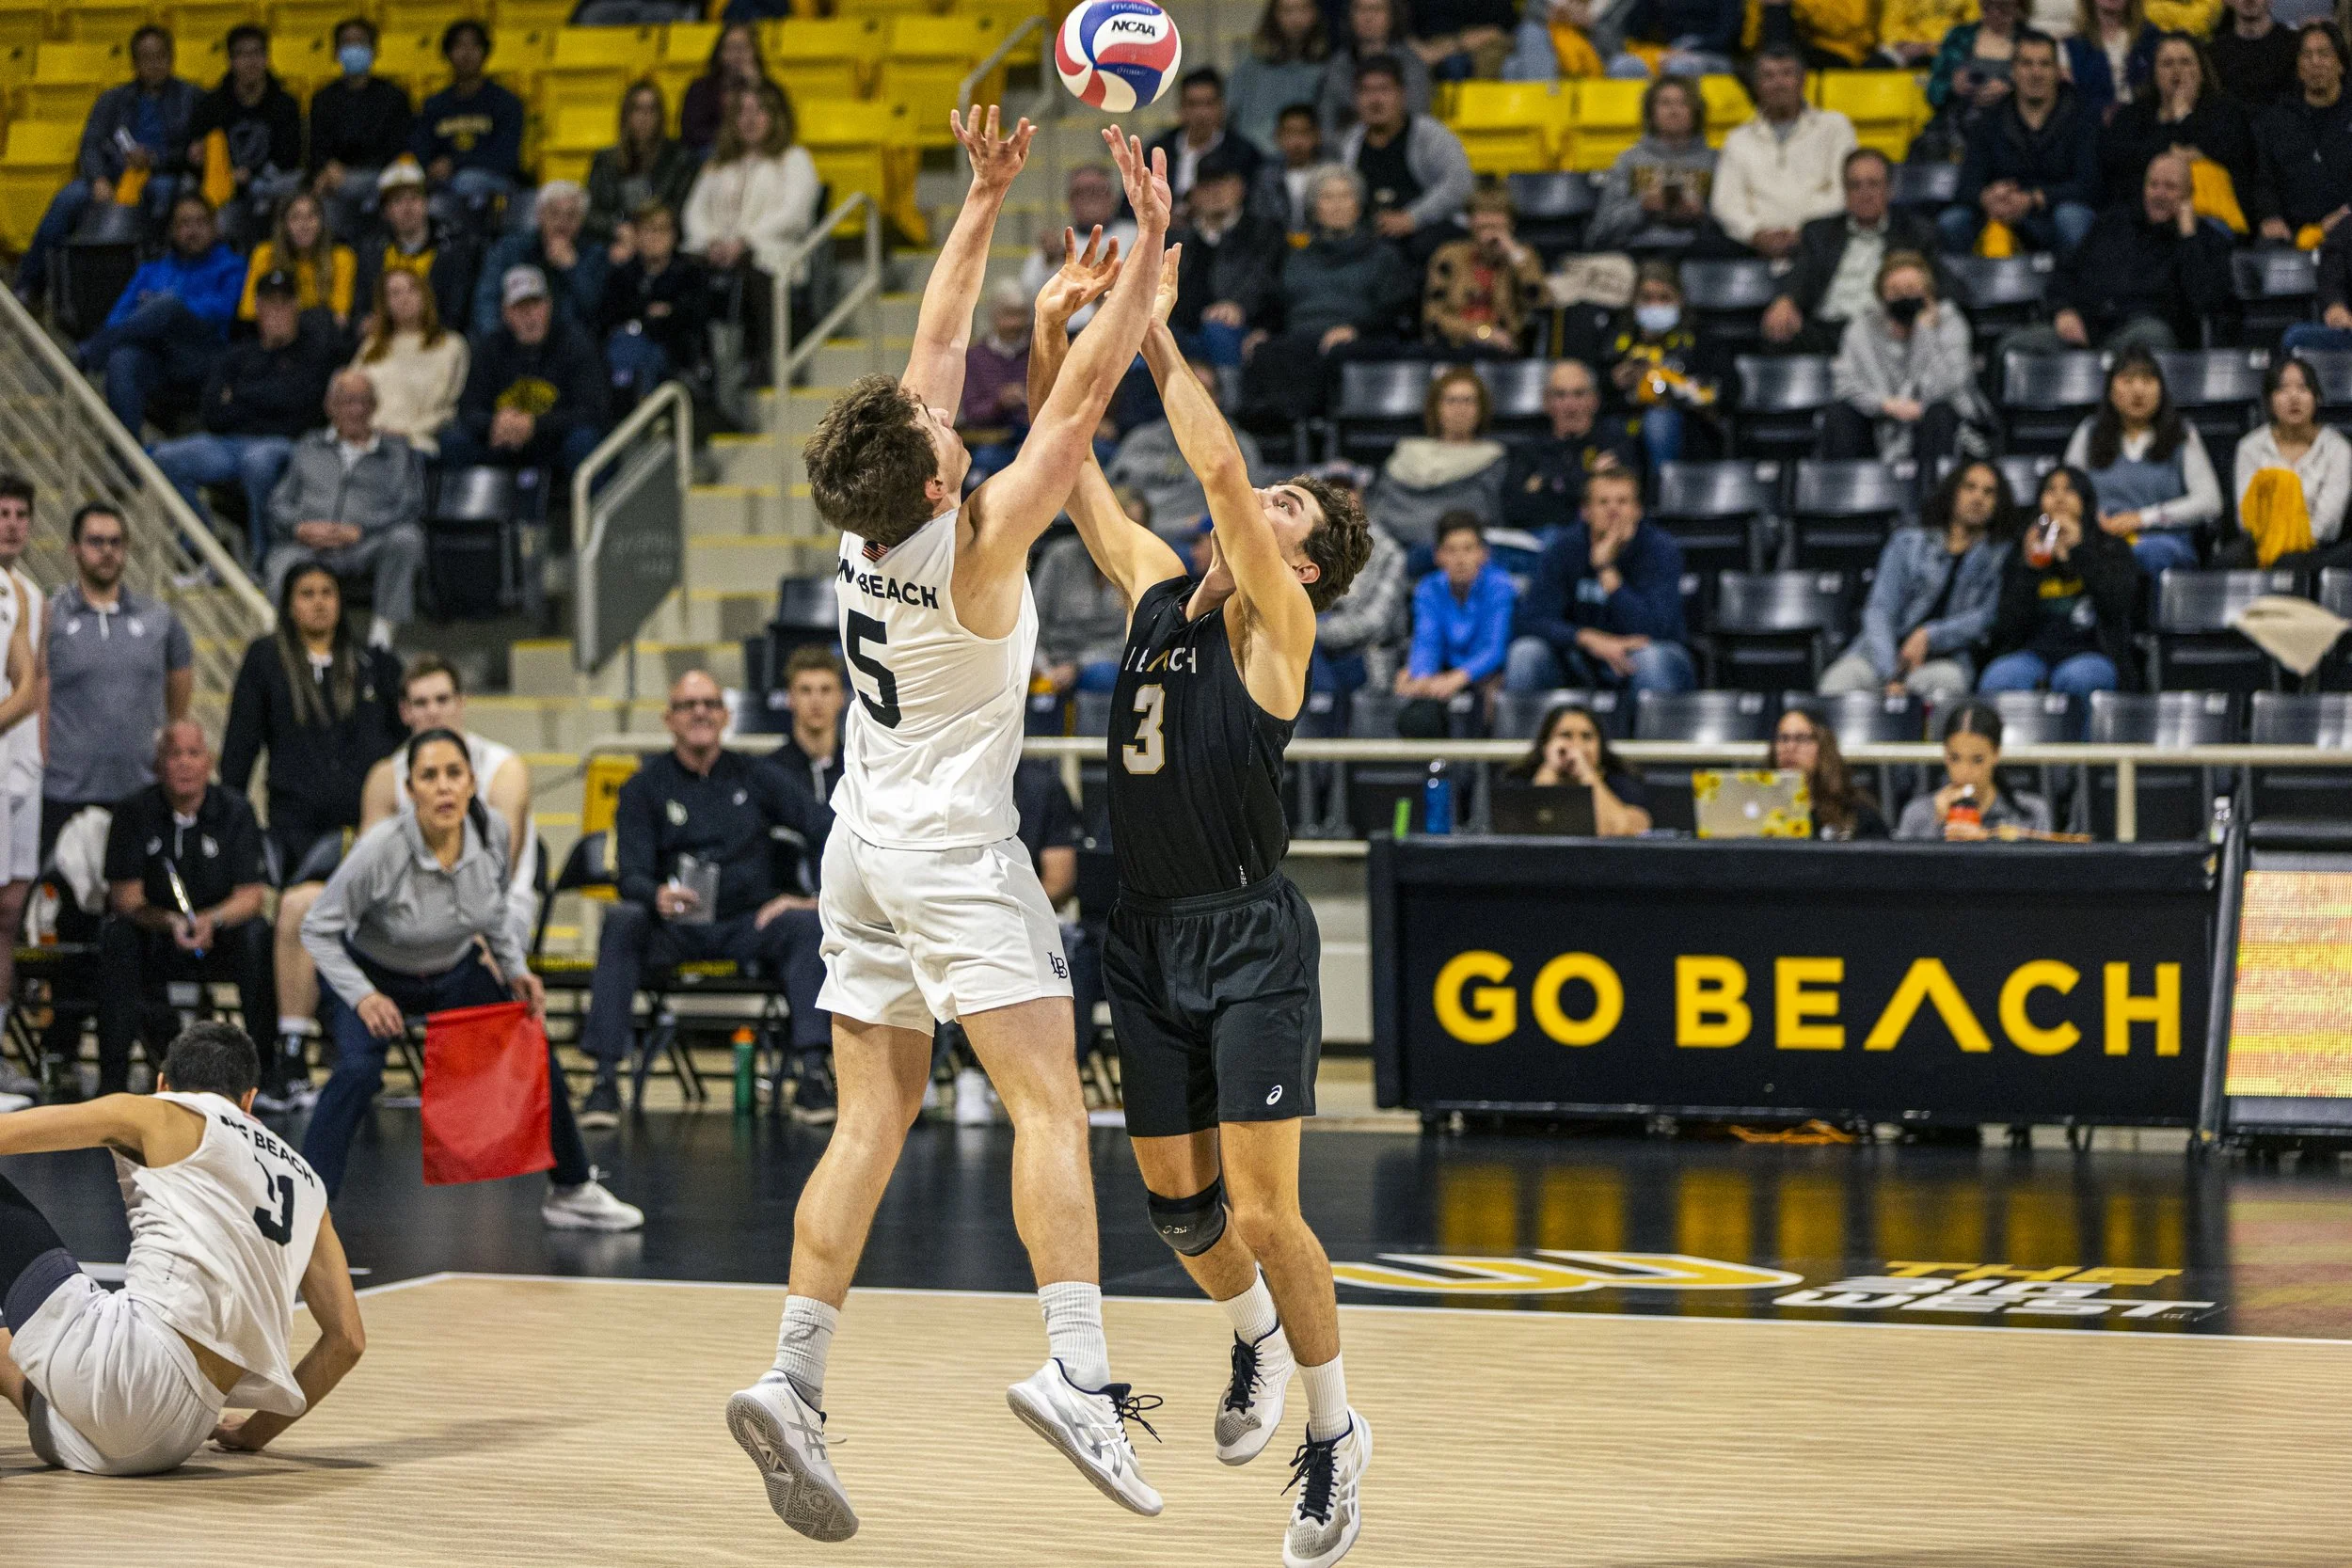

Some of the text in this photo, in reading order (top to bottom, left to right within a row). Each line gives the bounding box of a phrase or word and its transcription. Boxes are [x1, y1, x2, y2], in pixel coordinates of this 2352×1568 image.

[1111, 20, 1156, 37] NCAA
[858, 573, 939, 610] BEACH
[847, 609, 902, 729] 5
[1122, 683, 1166, 775] 3
[1433, 950, 2182, 1057] GO BEACH
[254, 1130, 314, 1188] BEACH
[1818, 1275, 2113, 1299] BIG
[1885, 1260, 2184, 1285] THE
[1772, 1290, 2216, 1317] WEST
